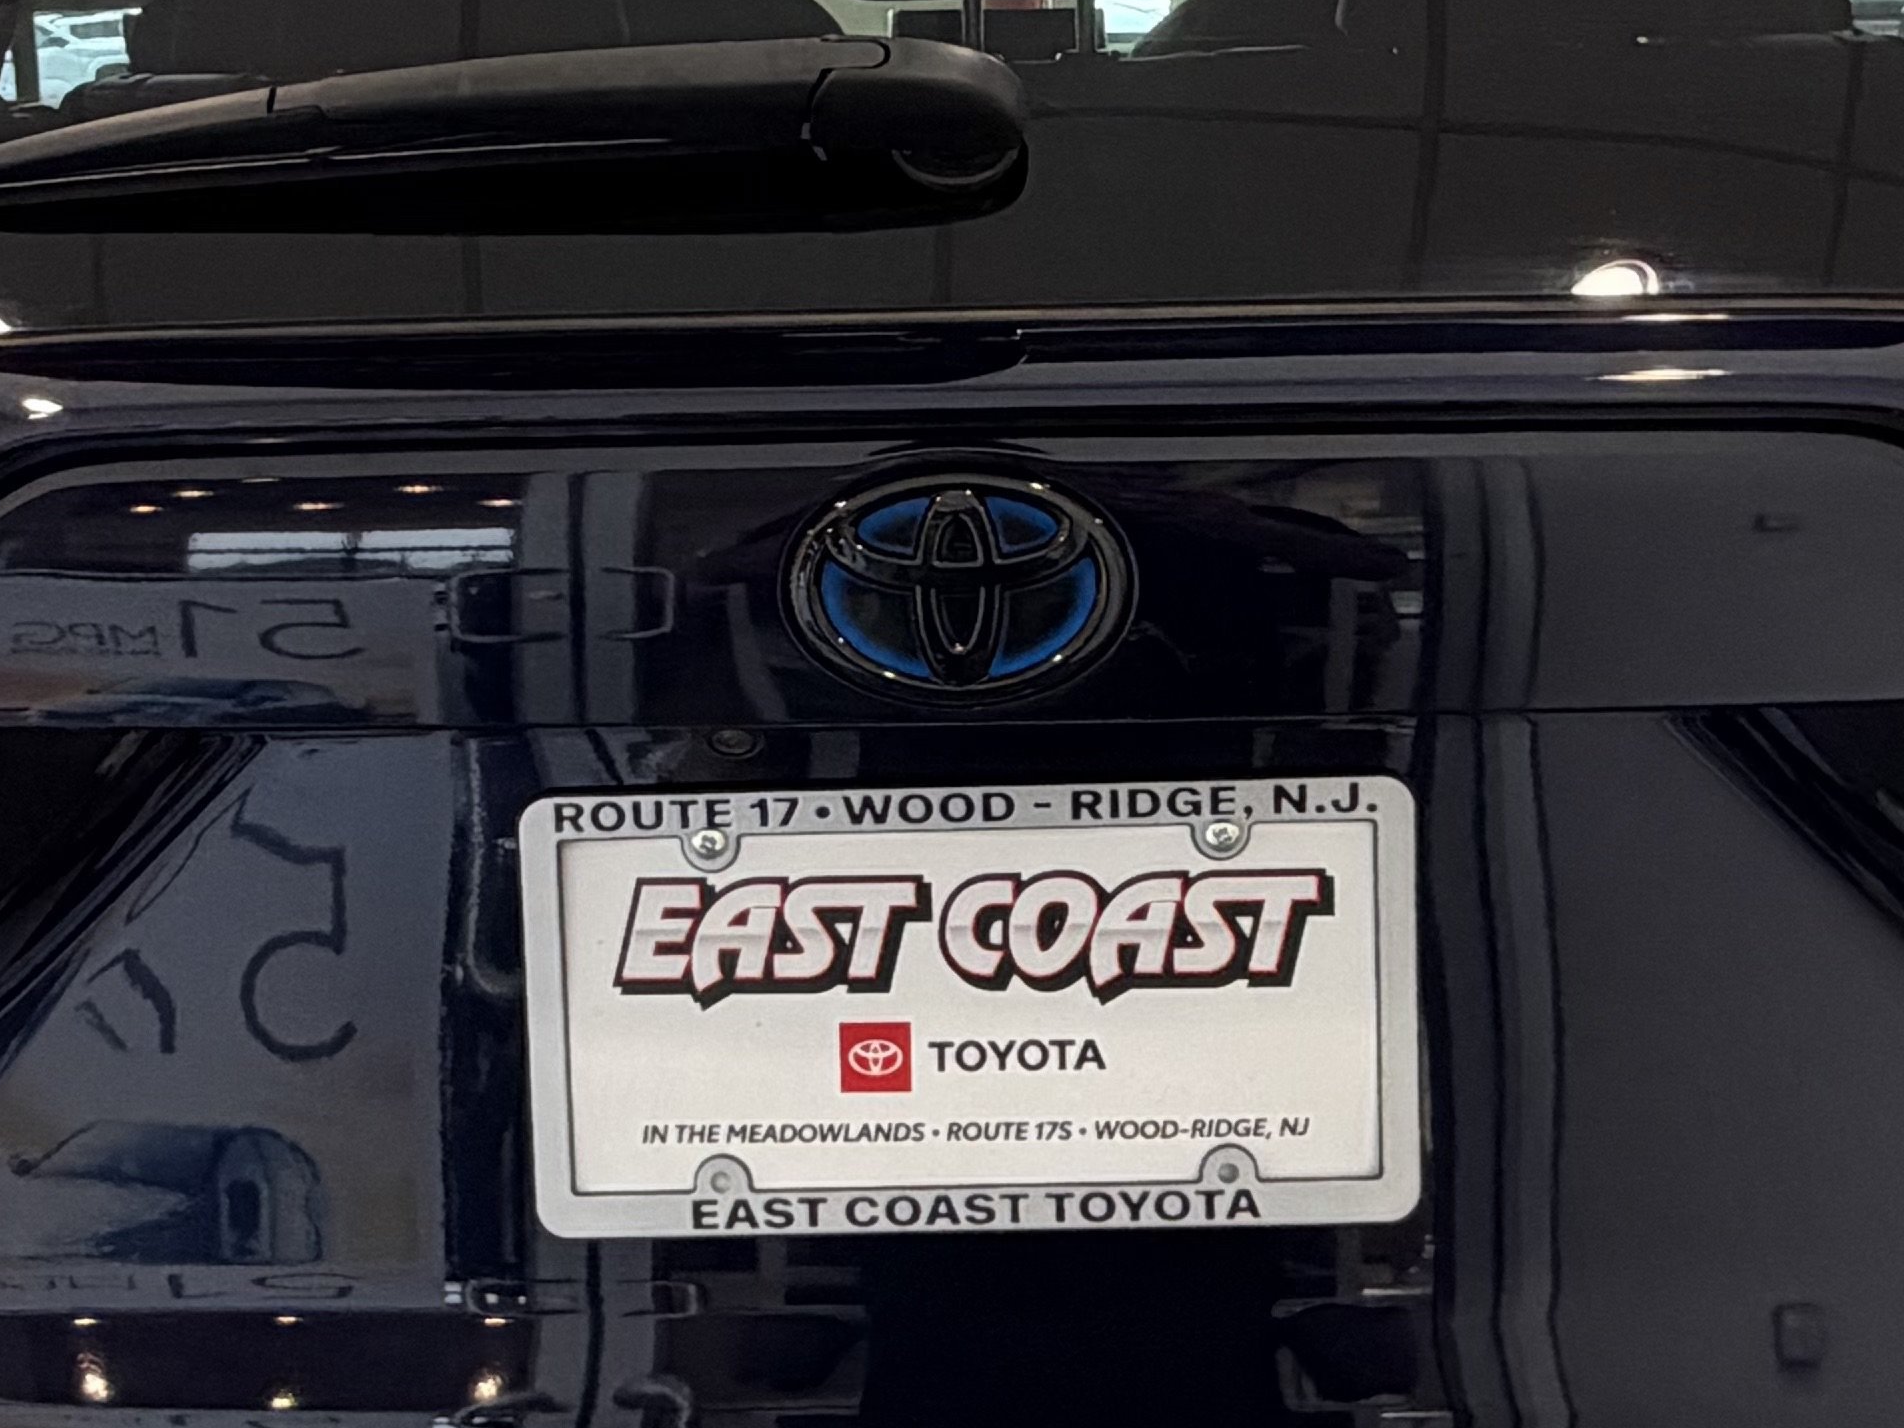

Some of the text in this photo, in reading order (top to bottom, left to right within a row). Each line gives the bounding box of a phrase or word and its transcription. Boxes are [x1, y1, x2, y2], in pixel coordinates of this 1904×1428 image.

[553, 798, 733, 834] ROUTE
[749, 797, 800, 828] 17
[841, 791, 1015, 826] WOOD
[1070, 785, 1253, 820] RIDGE,
[1272, 781, 1379, 815] N.J.
[612, 868, 1336, 1011] EAST COAST
[928, 1038, 1107, 1072] TOYOTA
[642, 1116, 1311, 1145] IN THE MEADOWLANDS ROUTE 17S WOOD-RIDGE, NJ
[691, 1188, 1261, 1231] EAST COAST TOYOTA
